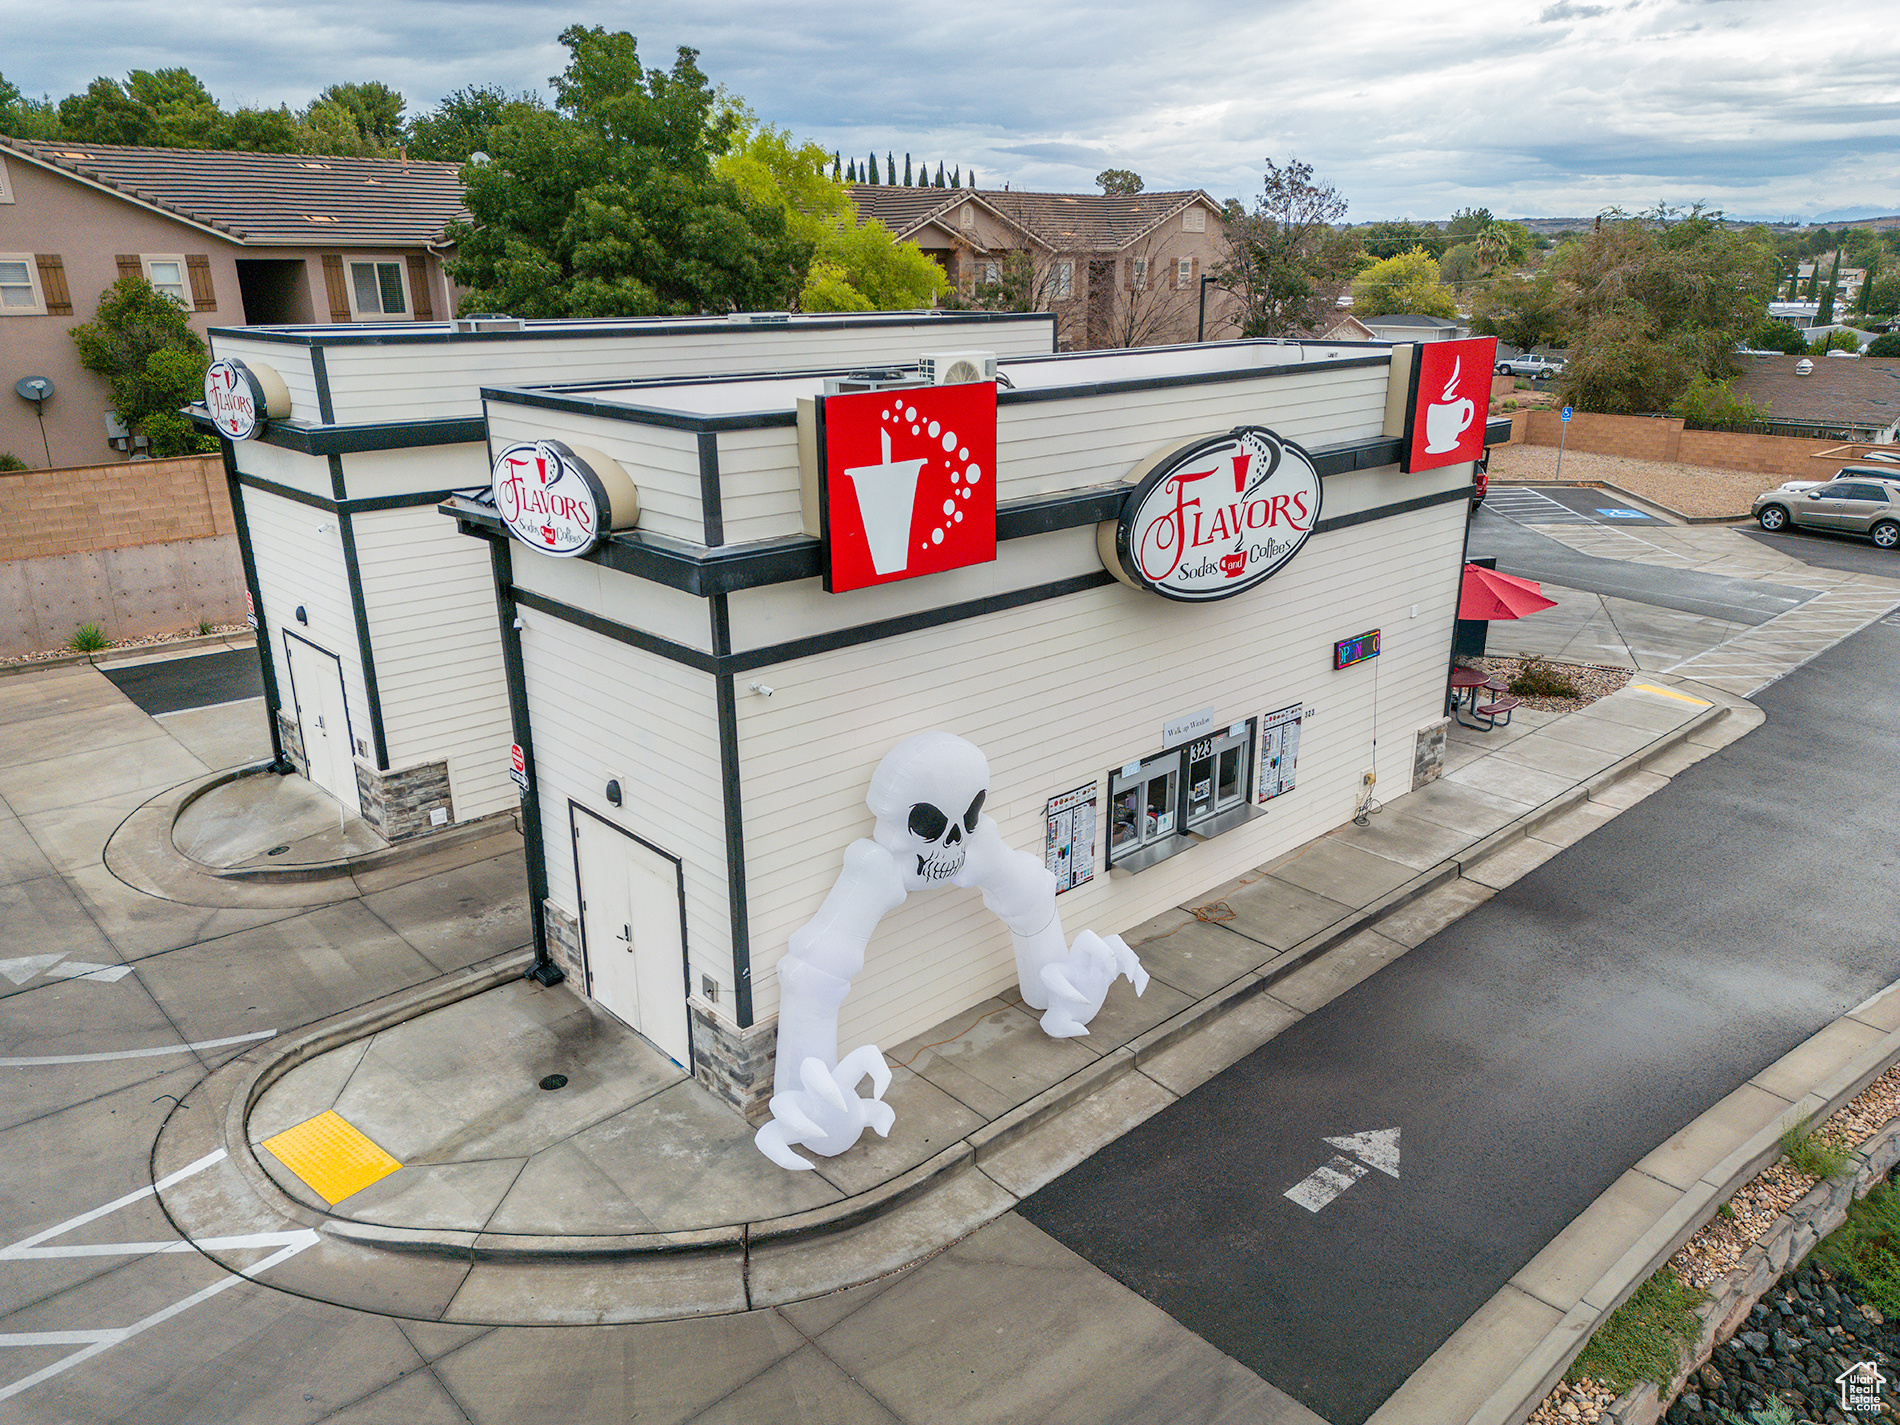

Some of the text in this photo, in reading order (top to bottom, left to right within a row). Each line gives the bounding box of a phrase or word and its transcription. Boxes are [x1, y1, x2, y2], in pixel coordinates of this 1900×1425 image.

[209, 373, 254, 421] FLAVORS
[499, 458, 594, 535] FLAVORS
[1141, 466, 1310, 581] FLAVORS
[1178, 537, 1292, 581] Sodas and Coffees
[1304, 708, 1315, 718] 323
[1192, 738, 1212, 761] 323
